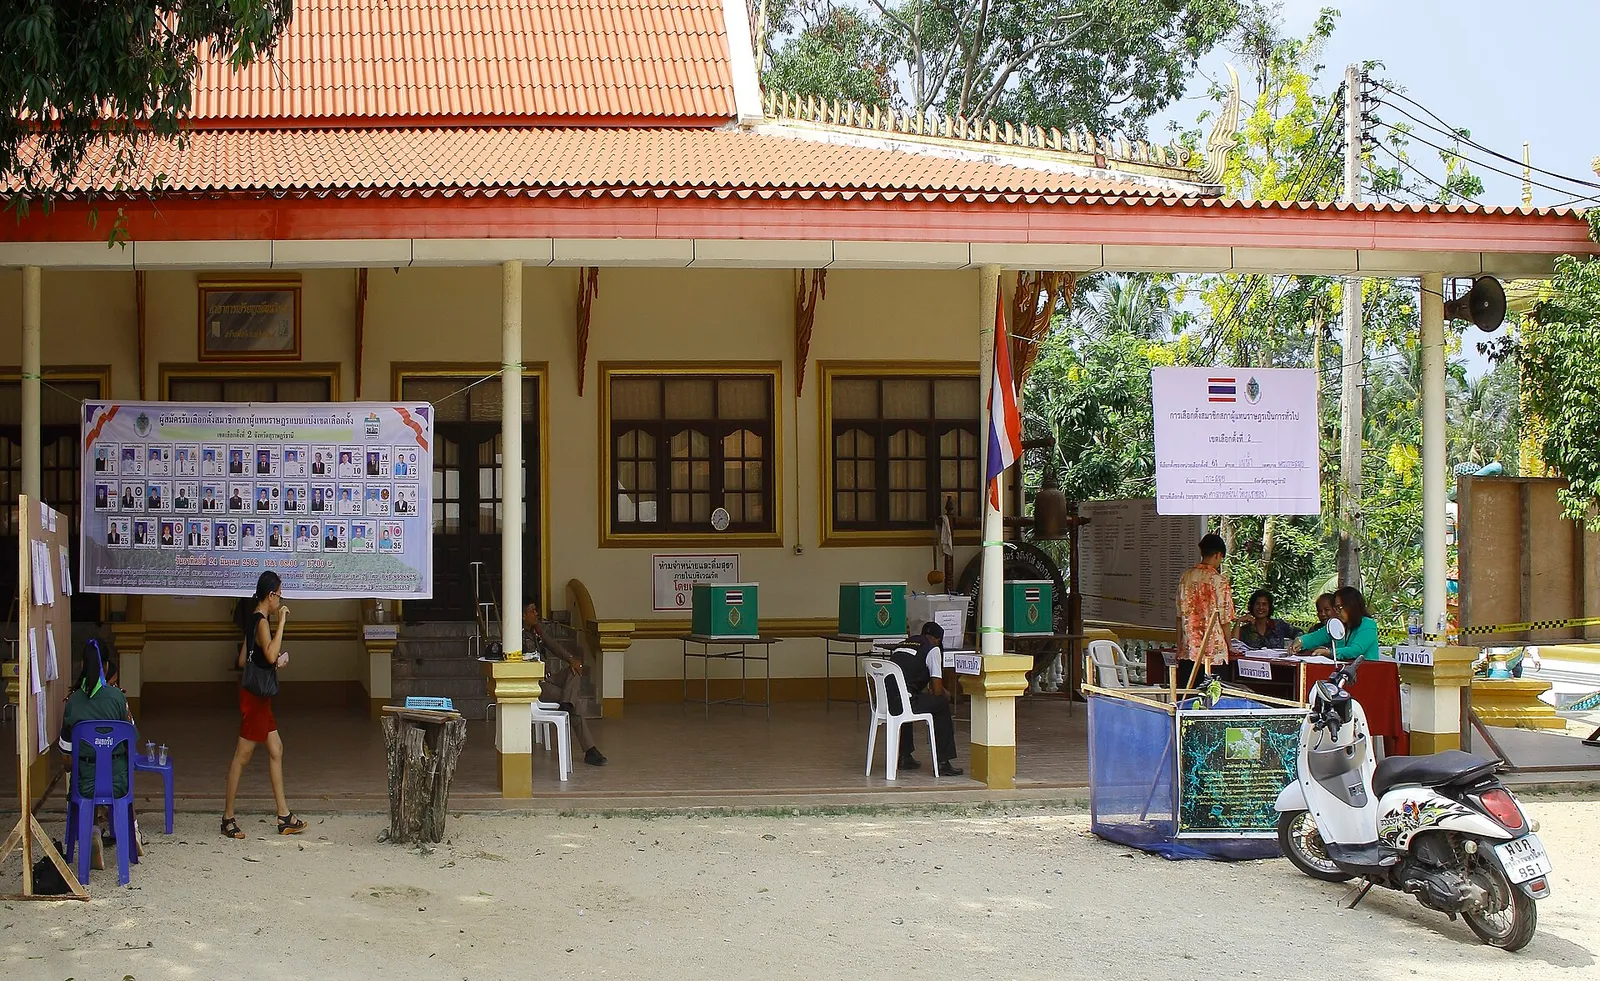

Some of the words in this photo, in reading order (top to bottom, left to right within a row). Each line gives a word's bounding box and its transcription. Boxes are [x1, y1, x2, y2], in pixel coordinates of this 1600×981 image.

[160, 410, 354, 426] ผู้สมัครรับเลือกตั้งสมาชิกสภาผู้แทนราษฎรแบบแบ่งเขตเลือกตั้ง
[1170, 408, 1300, 422] การเลือกตั้งสมาชิกสภาผู้แทนราษฎรเป็นการทั่วไป
[1208, 430, 1243, 442] เขตเลือกตั้งที่
[1247, 433, 1251, 442] 2
[175, 553, 206, 566] วันอาทิตย์ที่
[208, 557, 218, 565] 24
[220, 555, 239, 566] มีนาคม
[242, 558, 259, 566] 2562
[659, 558, 733, 572] ห้ามจำหน่ายและดื่มสุรา
[1398, 649, 1430, 664] ทางเข้า
